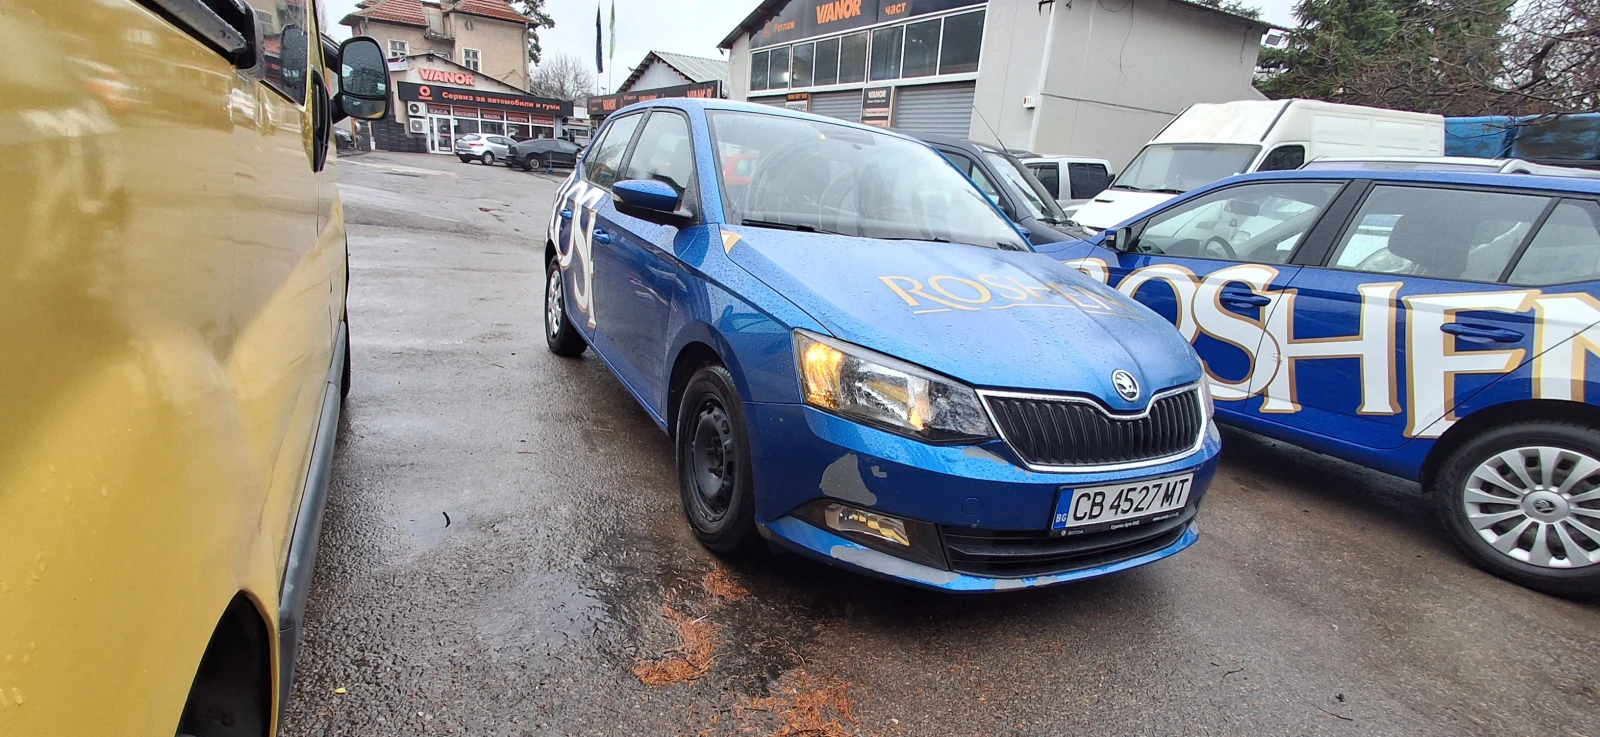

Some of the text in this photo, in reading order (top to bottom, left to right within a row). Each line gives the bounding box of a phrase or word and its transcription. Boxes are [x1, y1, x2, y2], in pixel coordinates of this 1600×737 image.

[816, 0, 861, 24] VIANOR
[773, 20, 796, 33] Реглаж
[419, 68, 475, 86] VIANOR
[441, 91, 474, 101] Сервиз
[487, 97, 534, 108] автомобили
[542, 103, 561, 111] гуми
[877, 274, 1137, 314] ROSHEN
[1109, 483, 1163, 516] 4527
[1055, 513, 1067, 523] BG
